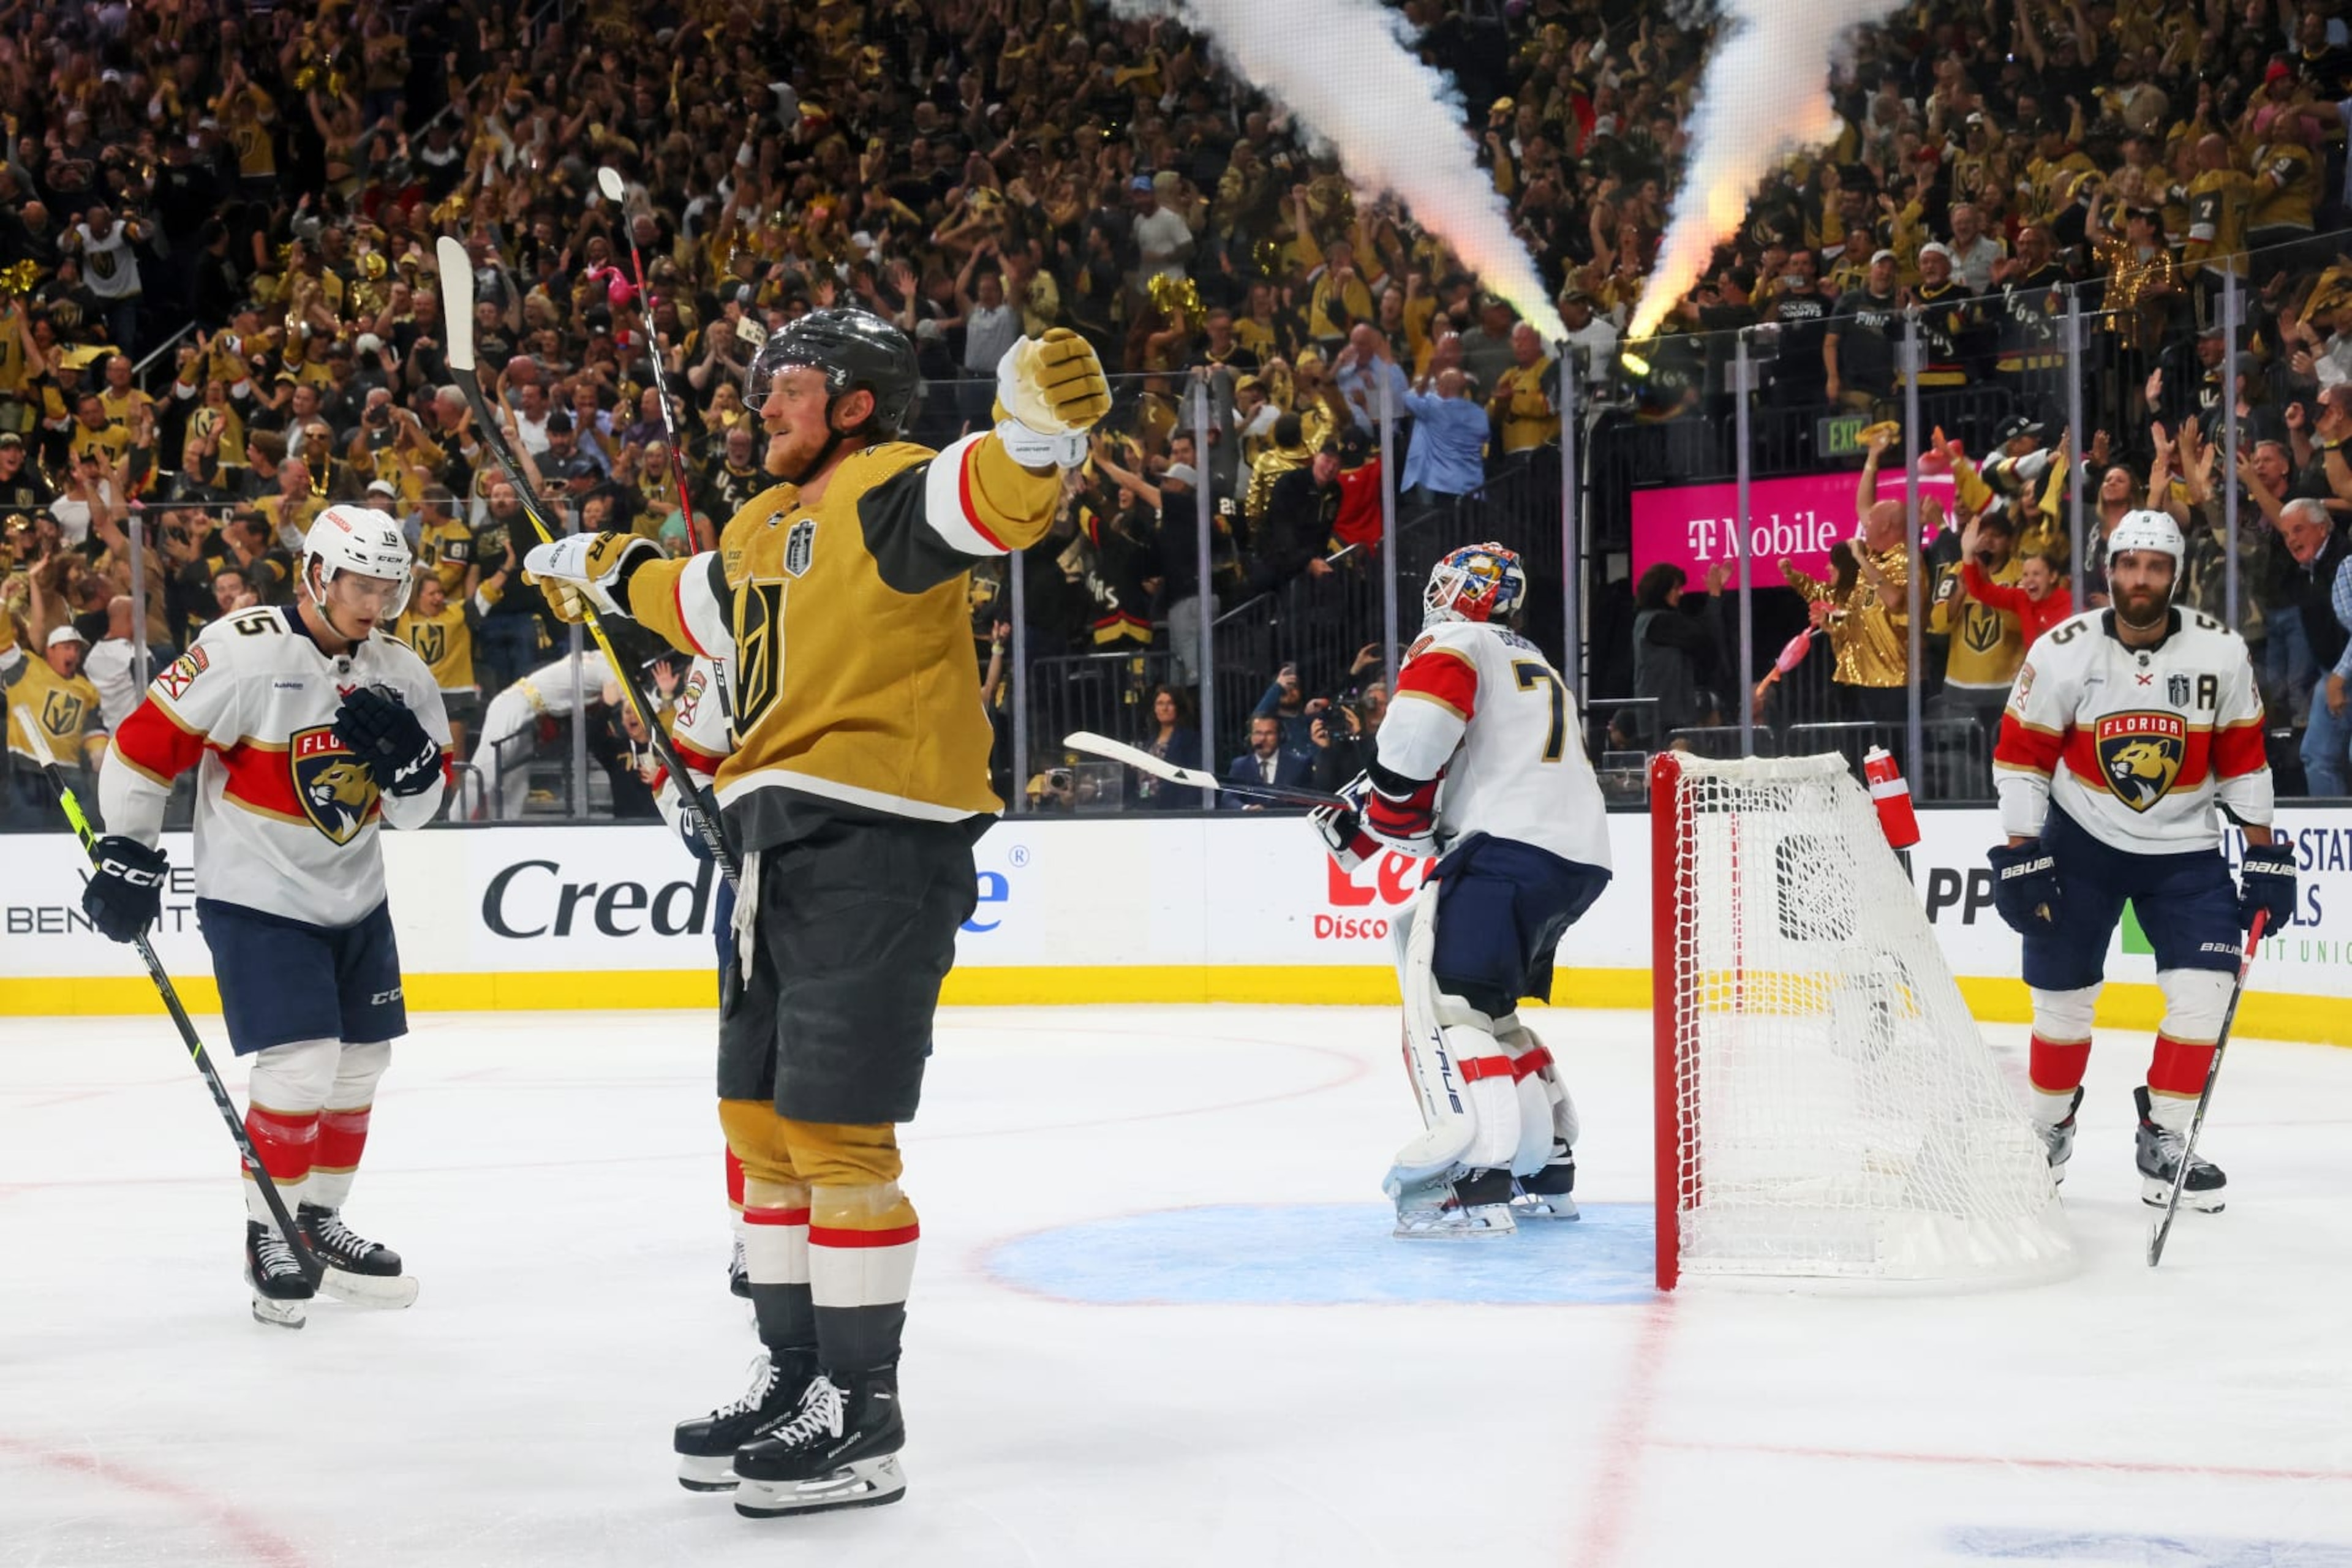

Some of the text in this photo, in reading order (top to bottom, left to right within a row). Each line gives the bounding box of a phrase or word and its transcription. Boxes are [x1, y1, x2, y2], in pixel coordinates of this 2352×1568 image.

[377, 554, 404, 564] CCM
[2197, 674, 2218, 710] A
[2105, 717, 2178, 736] FLORIDA
[303, 734, 341, 754] FLO
[482, 859, 715, 938] Cred
[7, 907, 202, 933] BENIT
[1314, 915, 1388, 939] Disco
[371, 987, 402, 1005] CC
